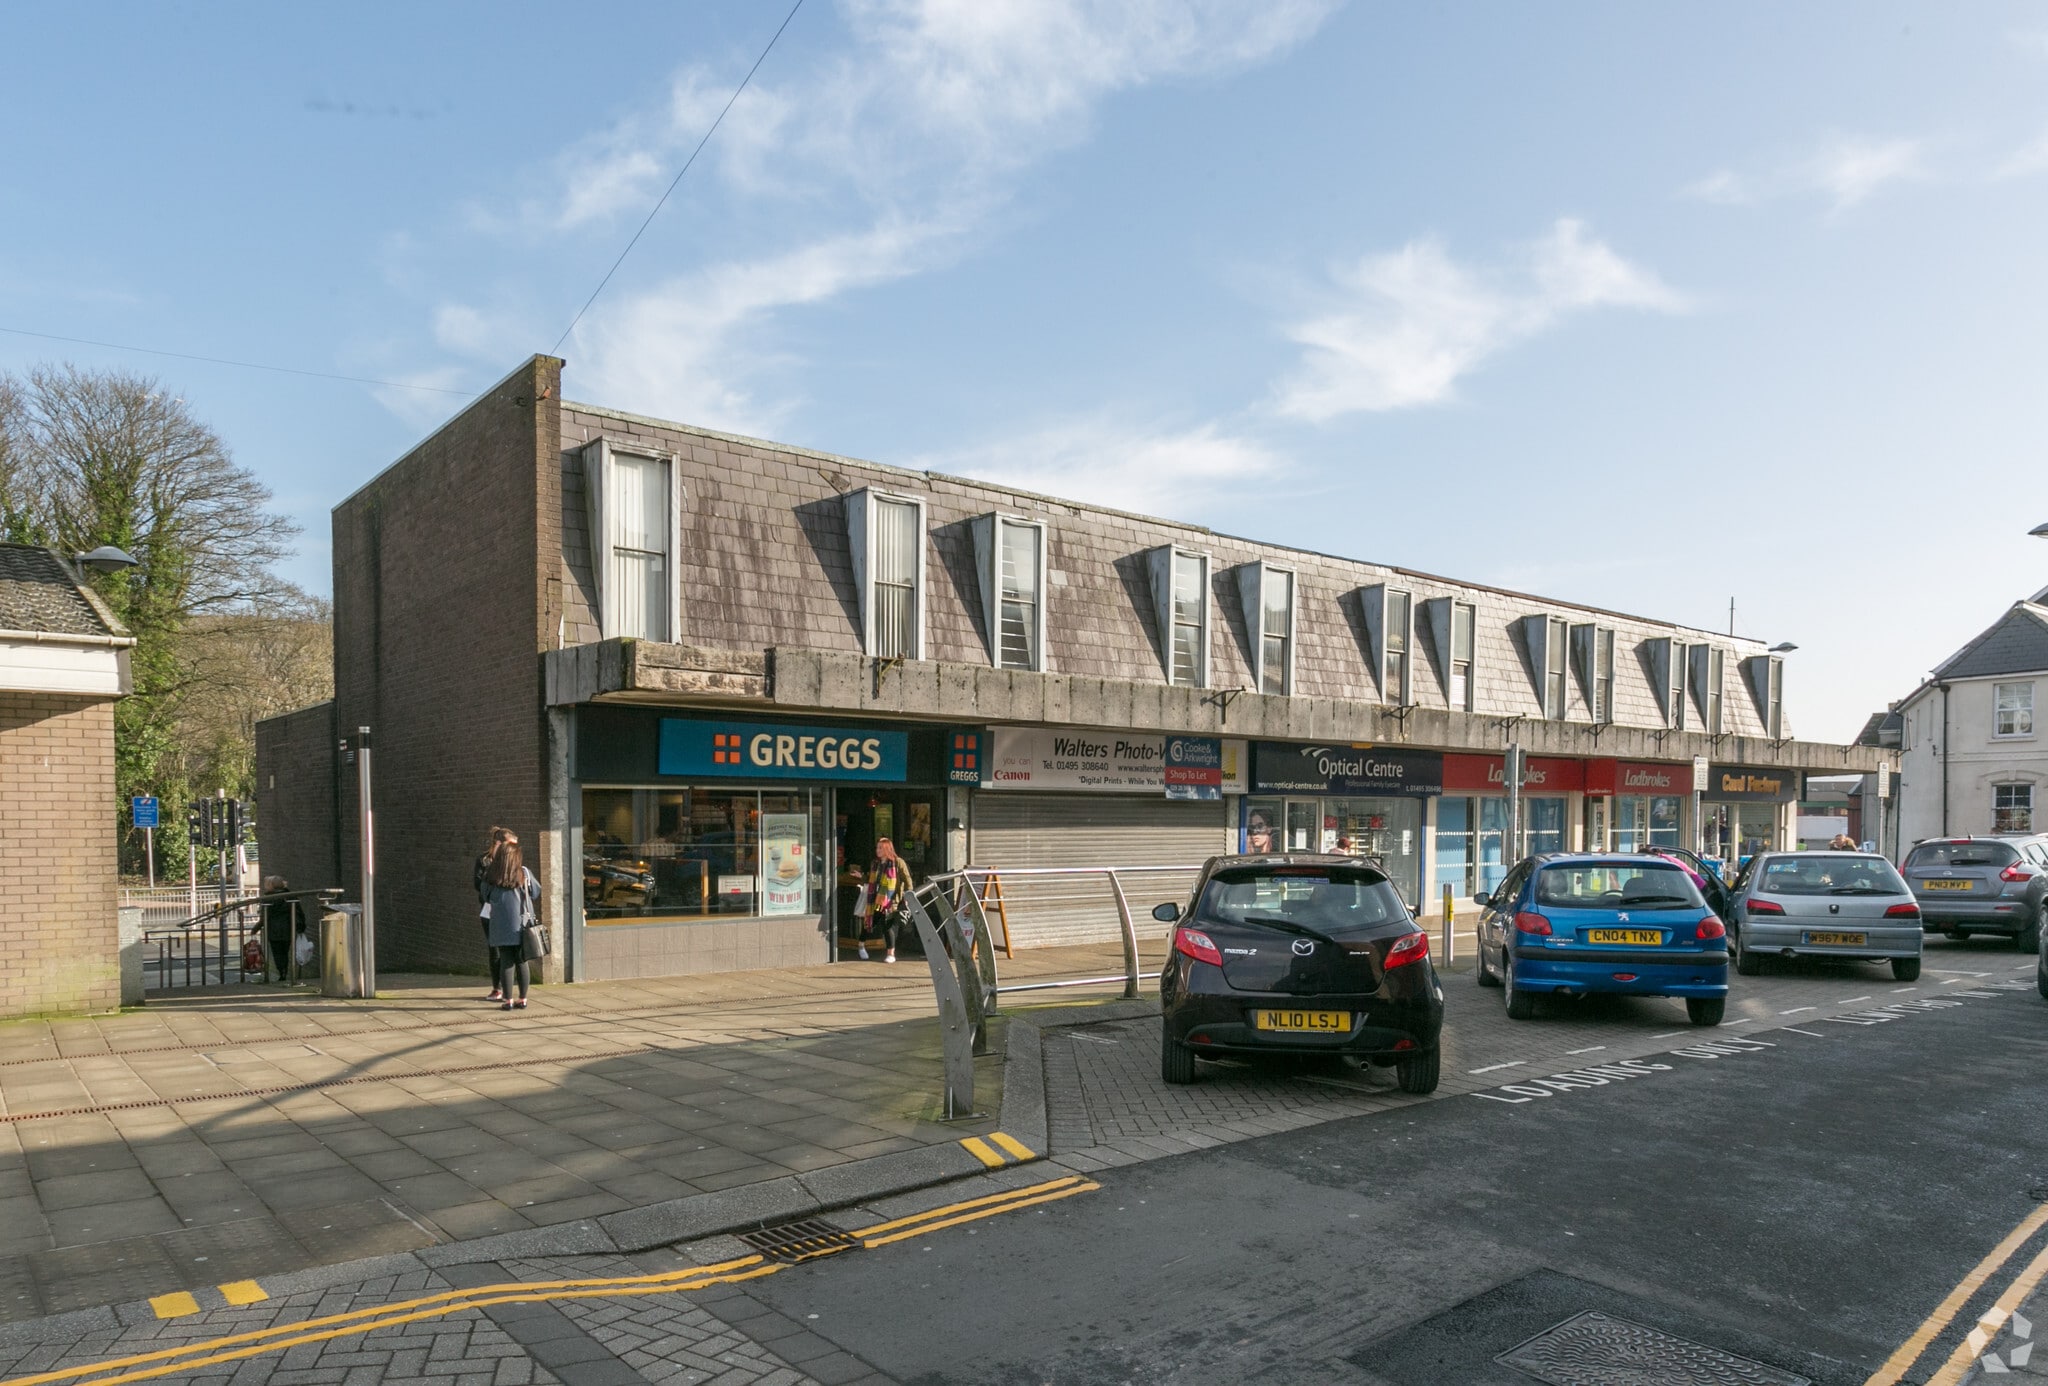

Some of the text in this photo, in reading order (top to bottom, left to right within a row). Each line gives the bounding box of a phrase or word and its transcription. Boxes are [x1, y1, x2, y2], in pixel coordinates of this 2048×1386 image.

[750, 733, 881, 770] GREGGS
[1054, 737, 1108, 758] Walters
[1003, 757, 1016, 766] you
[1042, 760, 1053, 769] Tel.
[1056, 761, 1079, 770] 01495
[1081, 761, 1109, 771] 308640
[1318, 757, 1403, 779] Optical Centre
[1487, 763, 1546, 784] Laokes
[950, 770, 979, 782] GREGGS
[993, 770, 1030, 780] Canon
[1103, 776, 1122, 785] Prints
[1127, 777, 1145, 785] While
[1170, 769, 1207, 780] Shop To Let
[1222, 771, 1236, 780] kon
[1624, 769, 1671, 787] Ladbrokes
[1257, 781, 1328, 790] www.optical-centre.co.uk
[1722, 773, 1746, 791] Card
[1747, 775, 1782, 796] Factory
[768, 891, 802, 903] WIN WIN
[1593, 930, 1656, 943] CN04 TNX
[1267, 1013, 1339, 1028] NL10 LSJ
[1471, 1058, 1673, 1104] LOADING
[1671, 1037, 1776, 1059] ONLY
